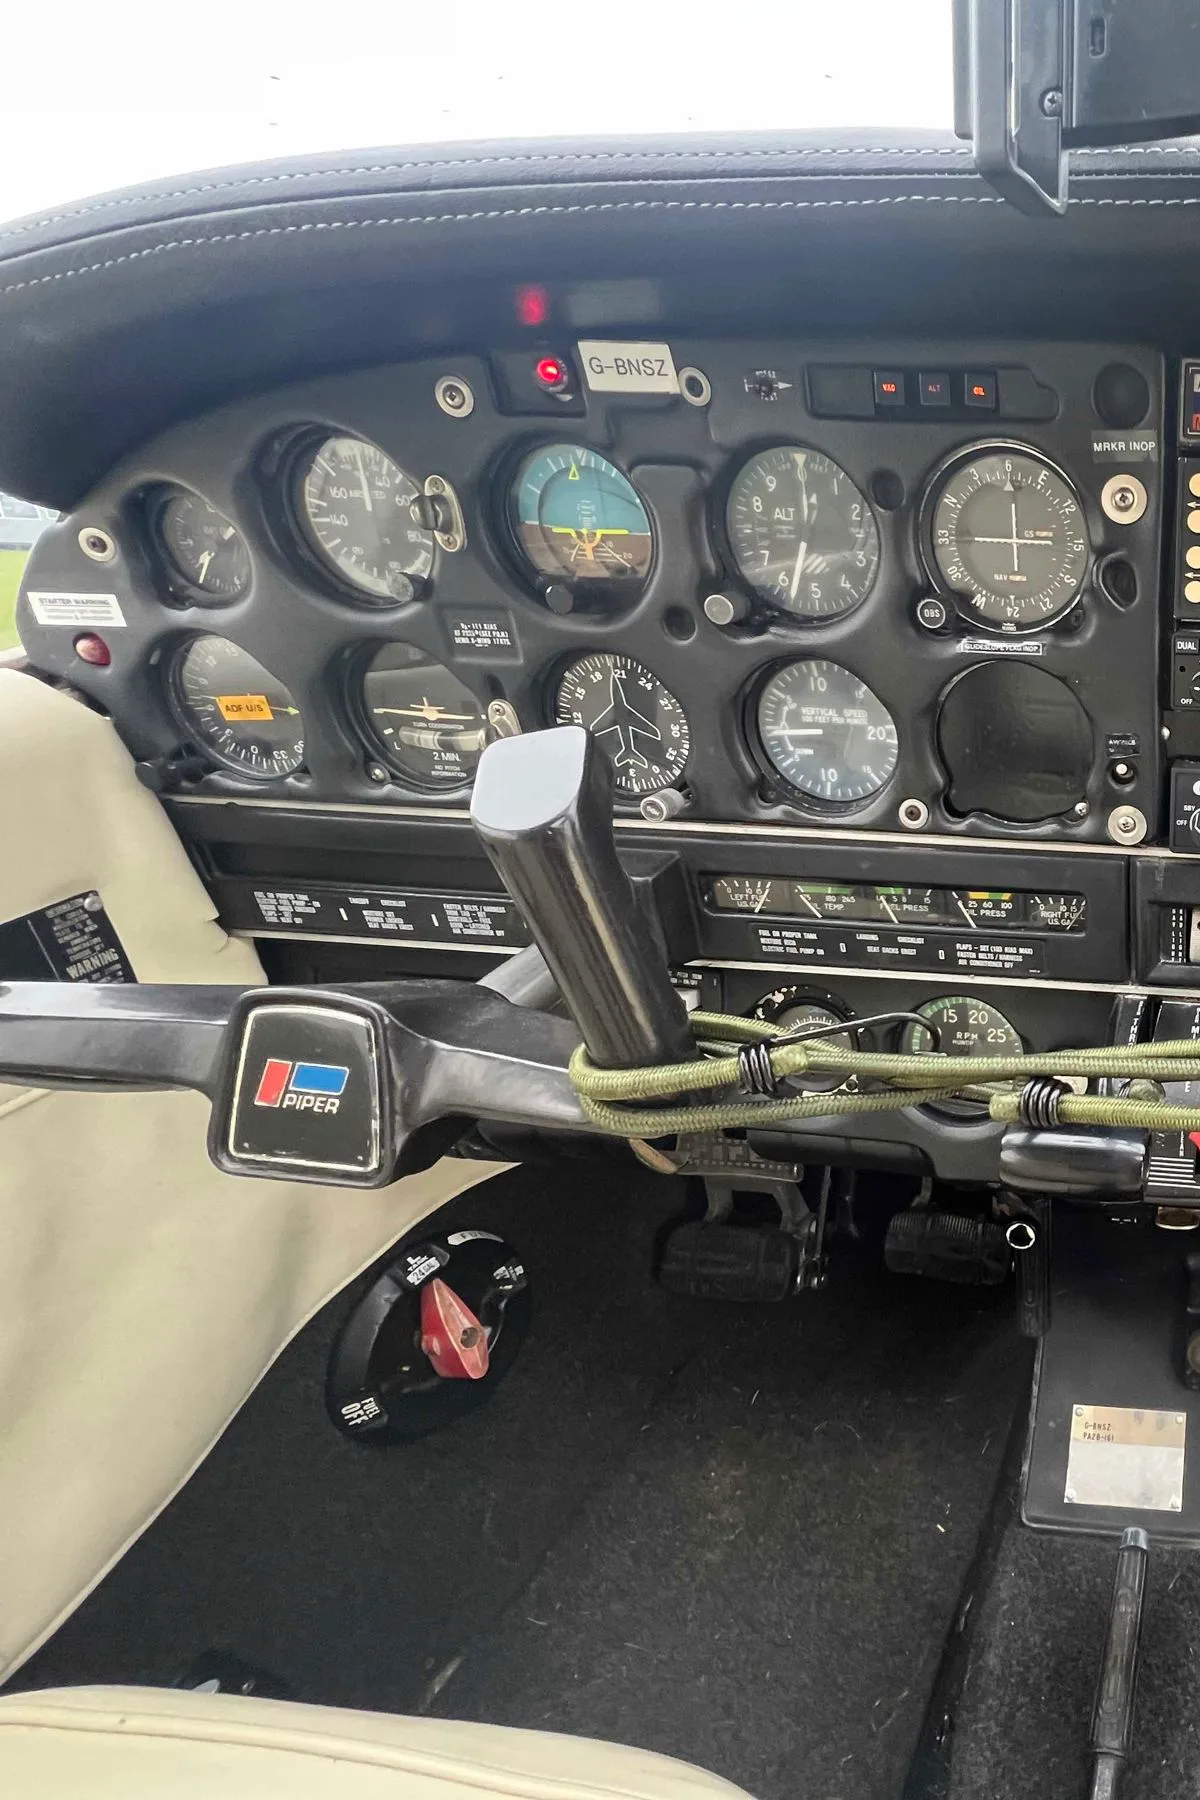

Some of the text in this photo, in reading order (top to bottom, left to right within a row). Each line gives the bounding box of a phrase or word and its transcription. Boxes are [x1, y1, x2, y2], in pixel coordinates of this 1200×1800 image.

[588, 356, 668, 376] G-BNSZ
[1093, 441, 1156, 452] MRKR INOP
[766, 476, 776, 492] 9
[752, 496, 763, 512] 8
[774, 508, 796, 520] ALT
[852, 504, 862, 520] 2
[760, 550, 770, 566] 7
[856, 551, 866, 568] 3
[778, 571, 790, 587] 6
[840, 574, 852, 588] 4
[811, 583, 822, 598] 5
[924, 609, 941, 618] OBS
[1177, 642, 1197, 651] DUAL
[614, 668, 627, 680] 21
[638, 676, 654, 691] 24
[810, 676, 828, 692] 10
[225, 704, 264, 713] ADF U/S
[658, 698, 673, 711] 27
[800, 706, 868, 718] VERTICAL SPEED
[573, 711, 584, 724] 12
[670, 723, 681, 738] 30
[867, 726, 886, 740] 20
[432, 752, 440, 760] 2
[665, 746, 678, 761] 33
[820, 767, 838, 782] 10
[1183, 804, 1196, 812] SBY
[902, 904, 929, 912] PRESS
[980, 910, 1006, 918] PRESS
[66, 948, 120, 980] WARNING
[943, 1008, 958, 1024] 15
[968, 1010, 988, 1024] 20
[956, 1032, 978, 1040] RPM
[987, 1028, 1006, 1043] 25
[282, 1094, 340, 1114] PIPER
[412, 1266, 426, 1282] 24
[340, 1402, 369, 1426] OFF
[360, 1396, 381, 1418] FUEL
[1084, 1422, 1112, 1431] G-BNSZ
